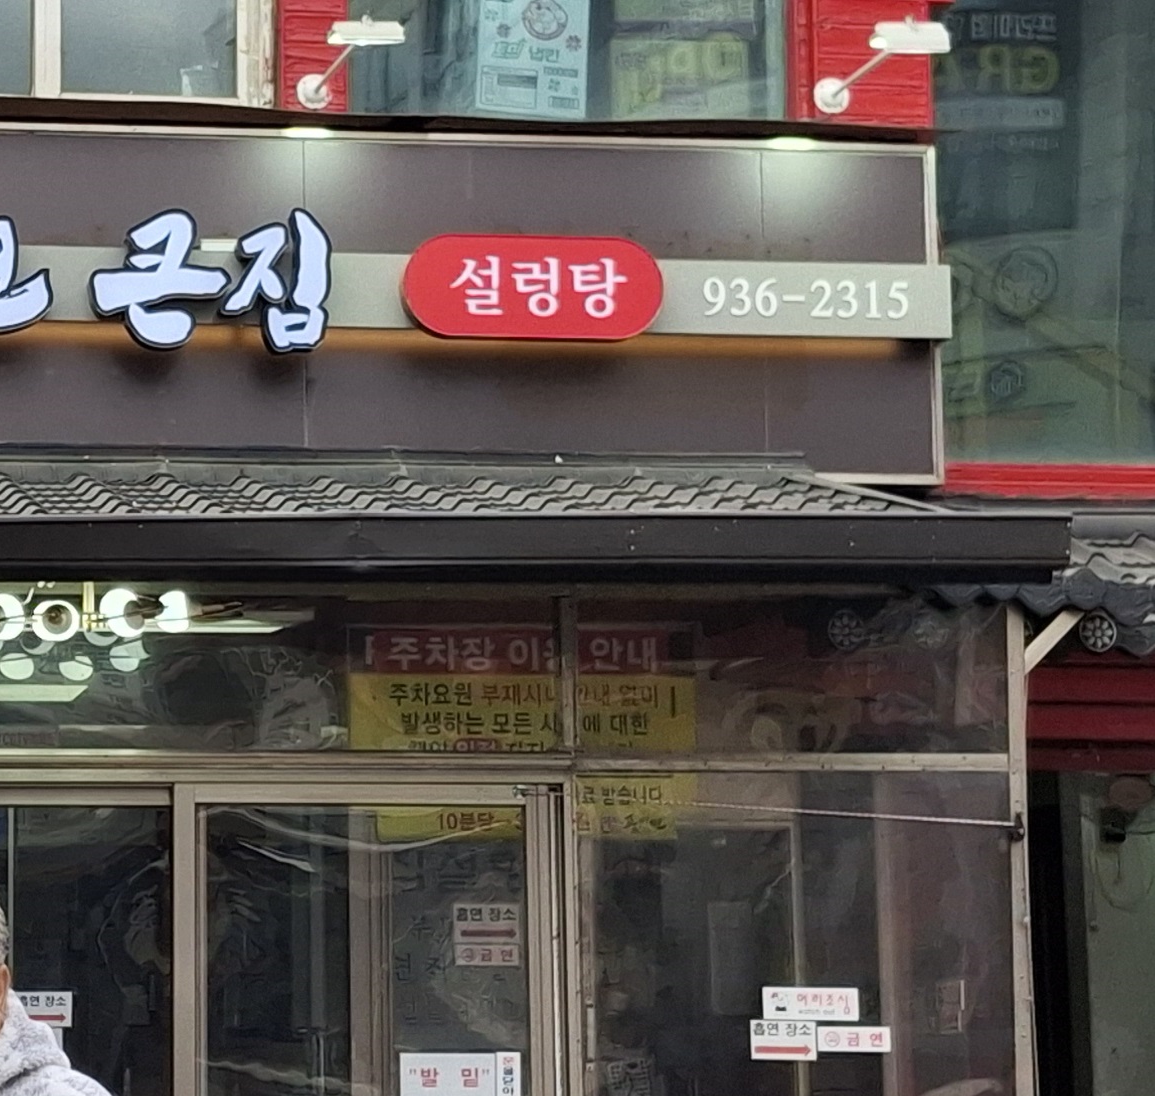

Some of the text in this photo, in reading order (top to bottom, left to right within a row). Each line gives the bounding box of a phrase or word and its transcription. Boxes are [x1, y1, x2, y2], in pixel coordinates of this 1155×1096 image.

[91, 208, 332, 354] 큰집
[450, 255, 627, 320] 설렁탕
[703, 277, 910, 321] 936-2315
[388, 635, 495, 671] 주차장
[590, 636, 657, 671] 안내
[389, 683, 473, 707] 주차요원
[400, 711, 486, 735] 발생하는
[492, 711, 531, 735] 모든
[610, 711, 648, 735] 대한
[489, 907, 517, 921] 장소
[45, 995, 67, 1007] 장소
[753, 1022, 812, 1036] 흡연 장소
